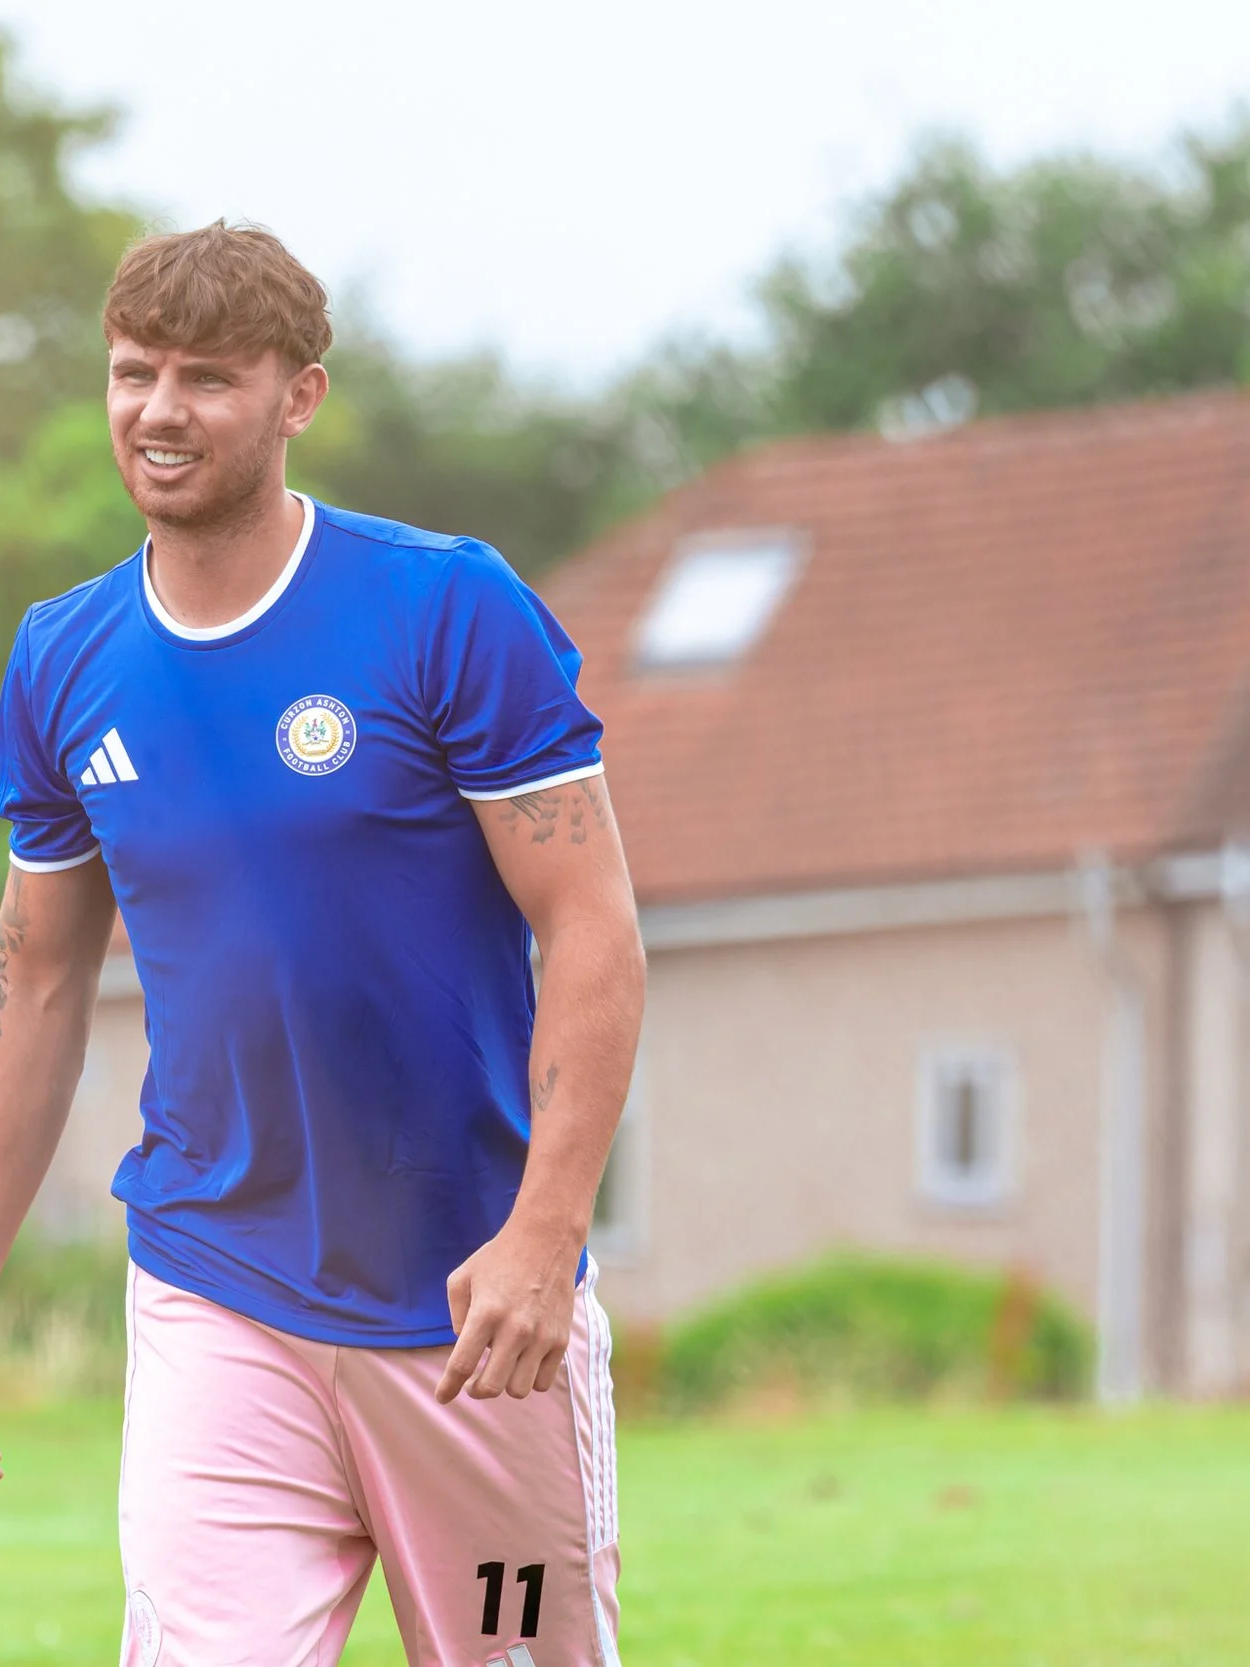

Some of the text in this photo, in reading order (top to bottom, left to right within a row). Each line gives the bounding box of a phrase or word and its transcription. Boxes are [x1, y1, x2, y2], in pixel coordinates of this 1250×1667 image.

[280, 698, 350, 730] CURZON ASHTON
[283, 741, 350, 772] FOOTBALL CLUB
[477, 1561, 545, 1638] 11
